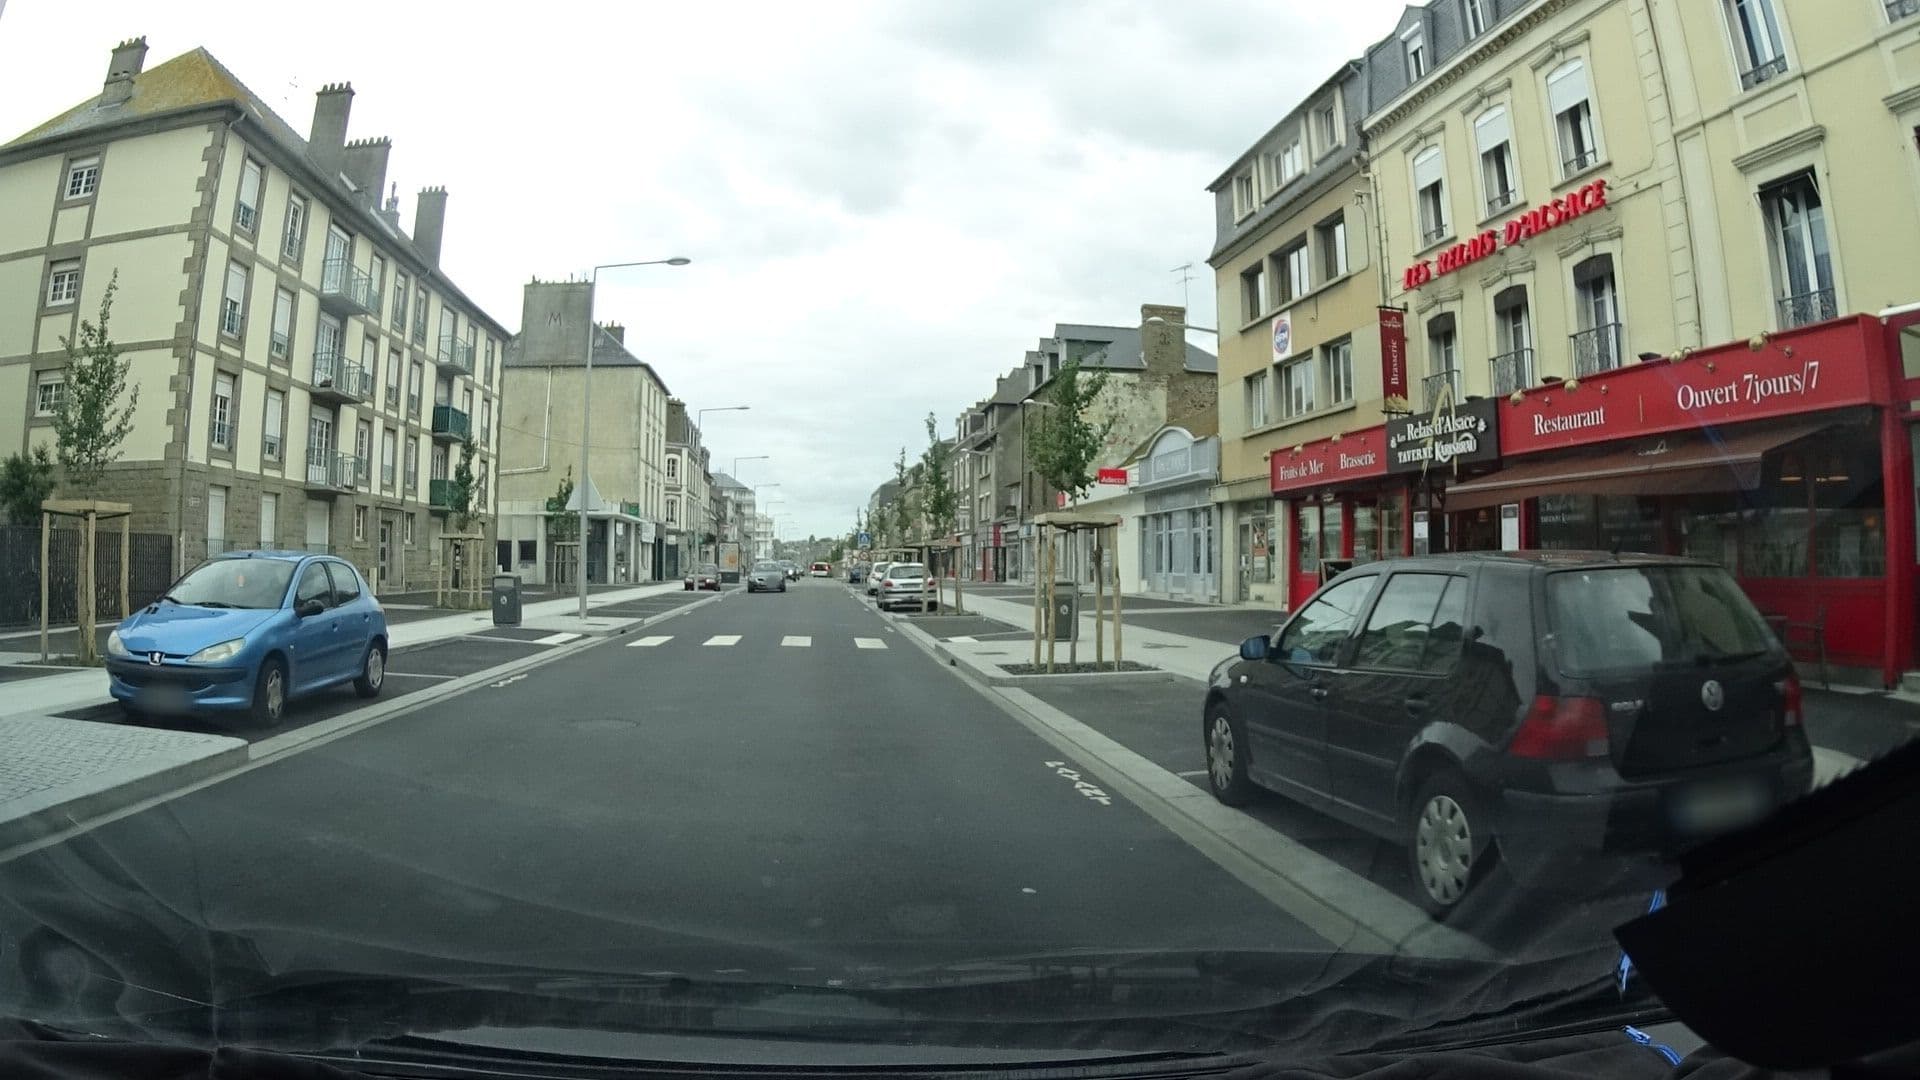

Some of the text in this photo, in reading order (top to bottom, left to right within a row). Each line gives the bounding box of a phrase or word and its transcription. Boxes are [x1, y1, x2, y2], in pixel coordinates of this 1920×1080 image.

[1403, 179, 1607, 291] LES RELAIS D'ALSACE
[1391, 340, 1399, 385] Brasserie
[1677, 360, 1820, 411] Ouvert 7jours/7
[1407, 420, 1433, 441] Relais
[1434, 415, 1476, 435] d'Alsace
[1534, 407, 1605, 436] Restaurant
[1340, 450, 1376, 470] Brasserie
[1397, 447, 1433, 463] TAVERNE
[1280, 458, 1324, 480] Fruits de Mer
